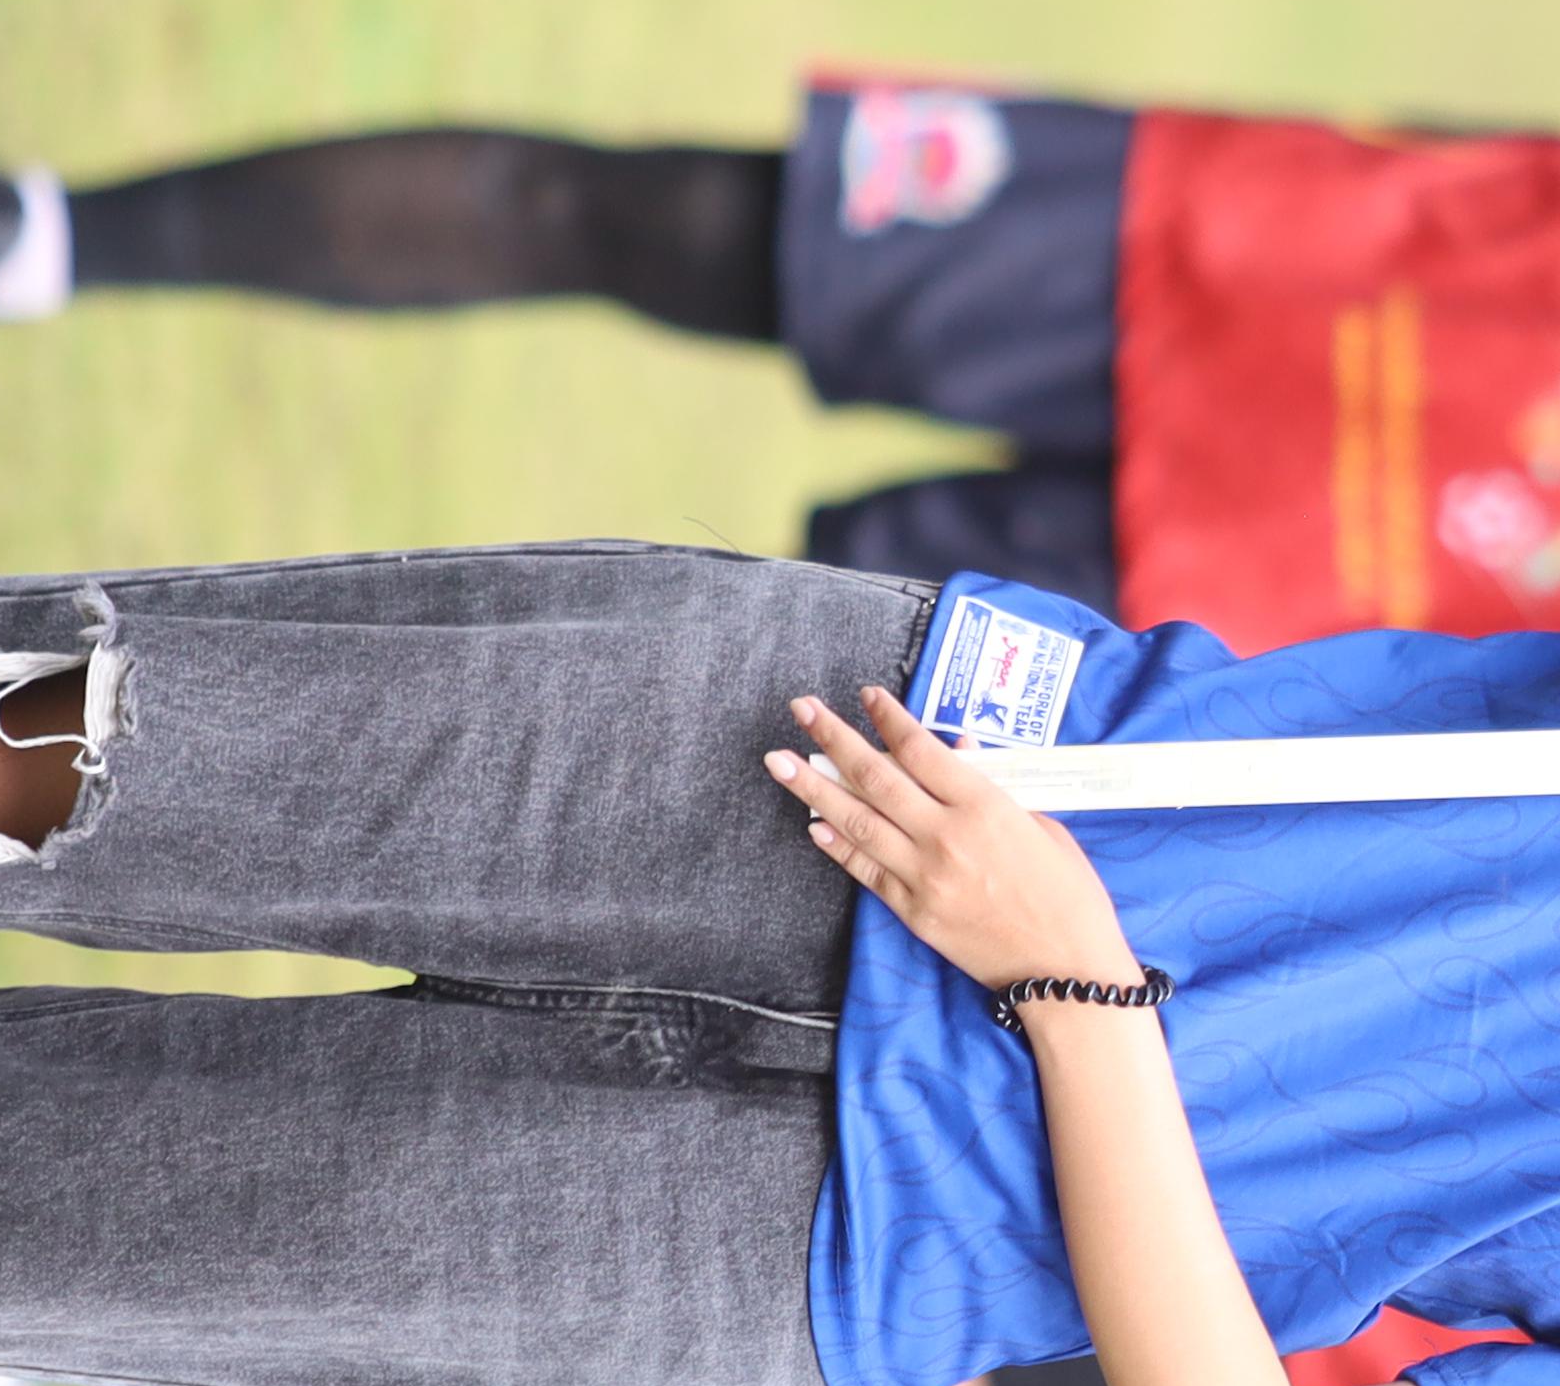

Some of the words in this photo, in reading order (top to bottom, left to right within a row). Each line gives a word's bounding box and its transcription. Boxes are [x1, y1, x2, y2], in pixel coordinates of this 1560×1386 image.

[1033, 669, 1059, 718] UNIFORM
[1012, 705, 1034, 738] TEAM
[1029, 721, 1044, 737] OF
